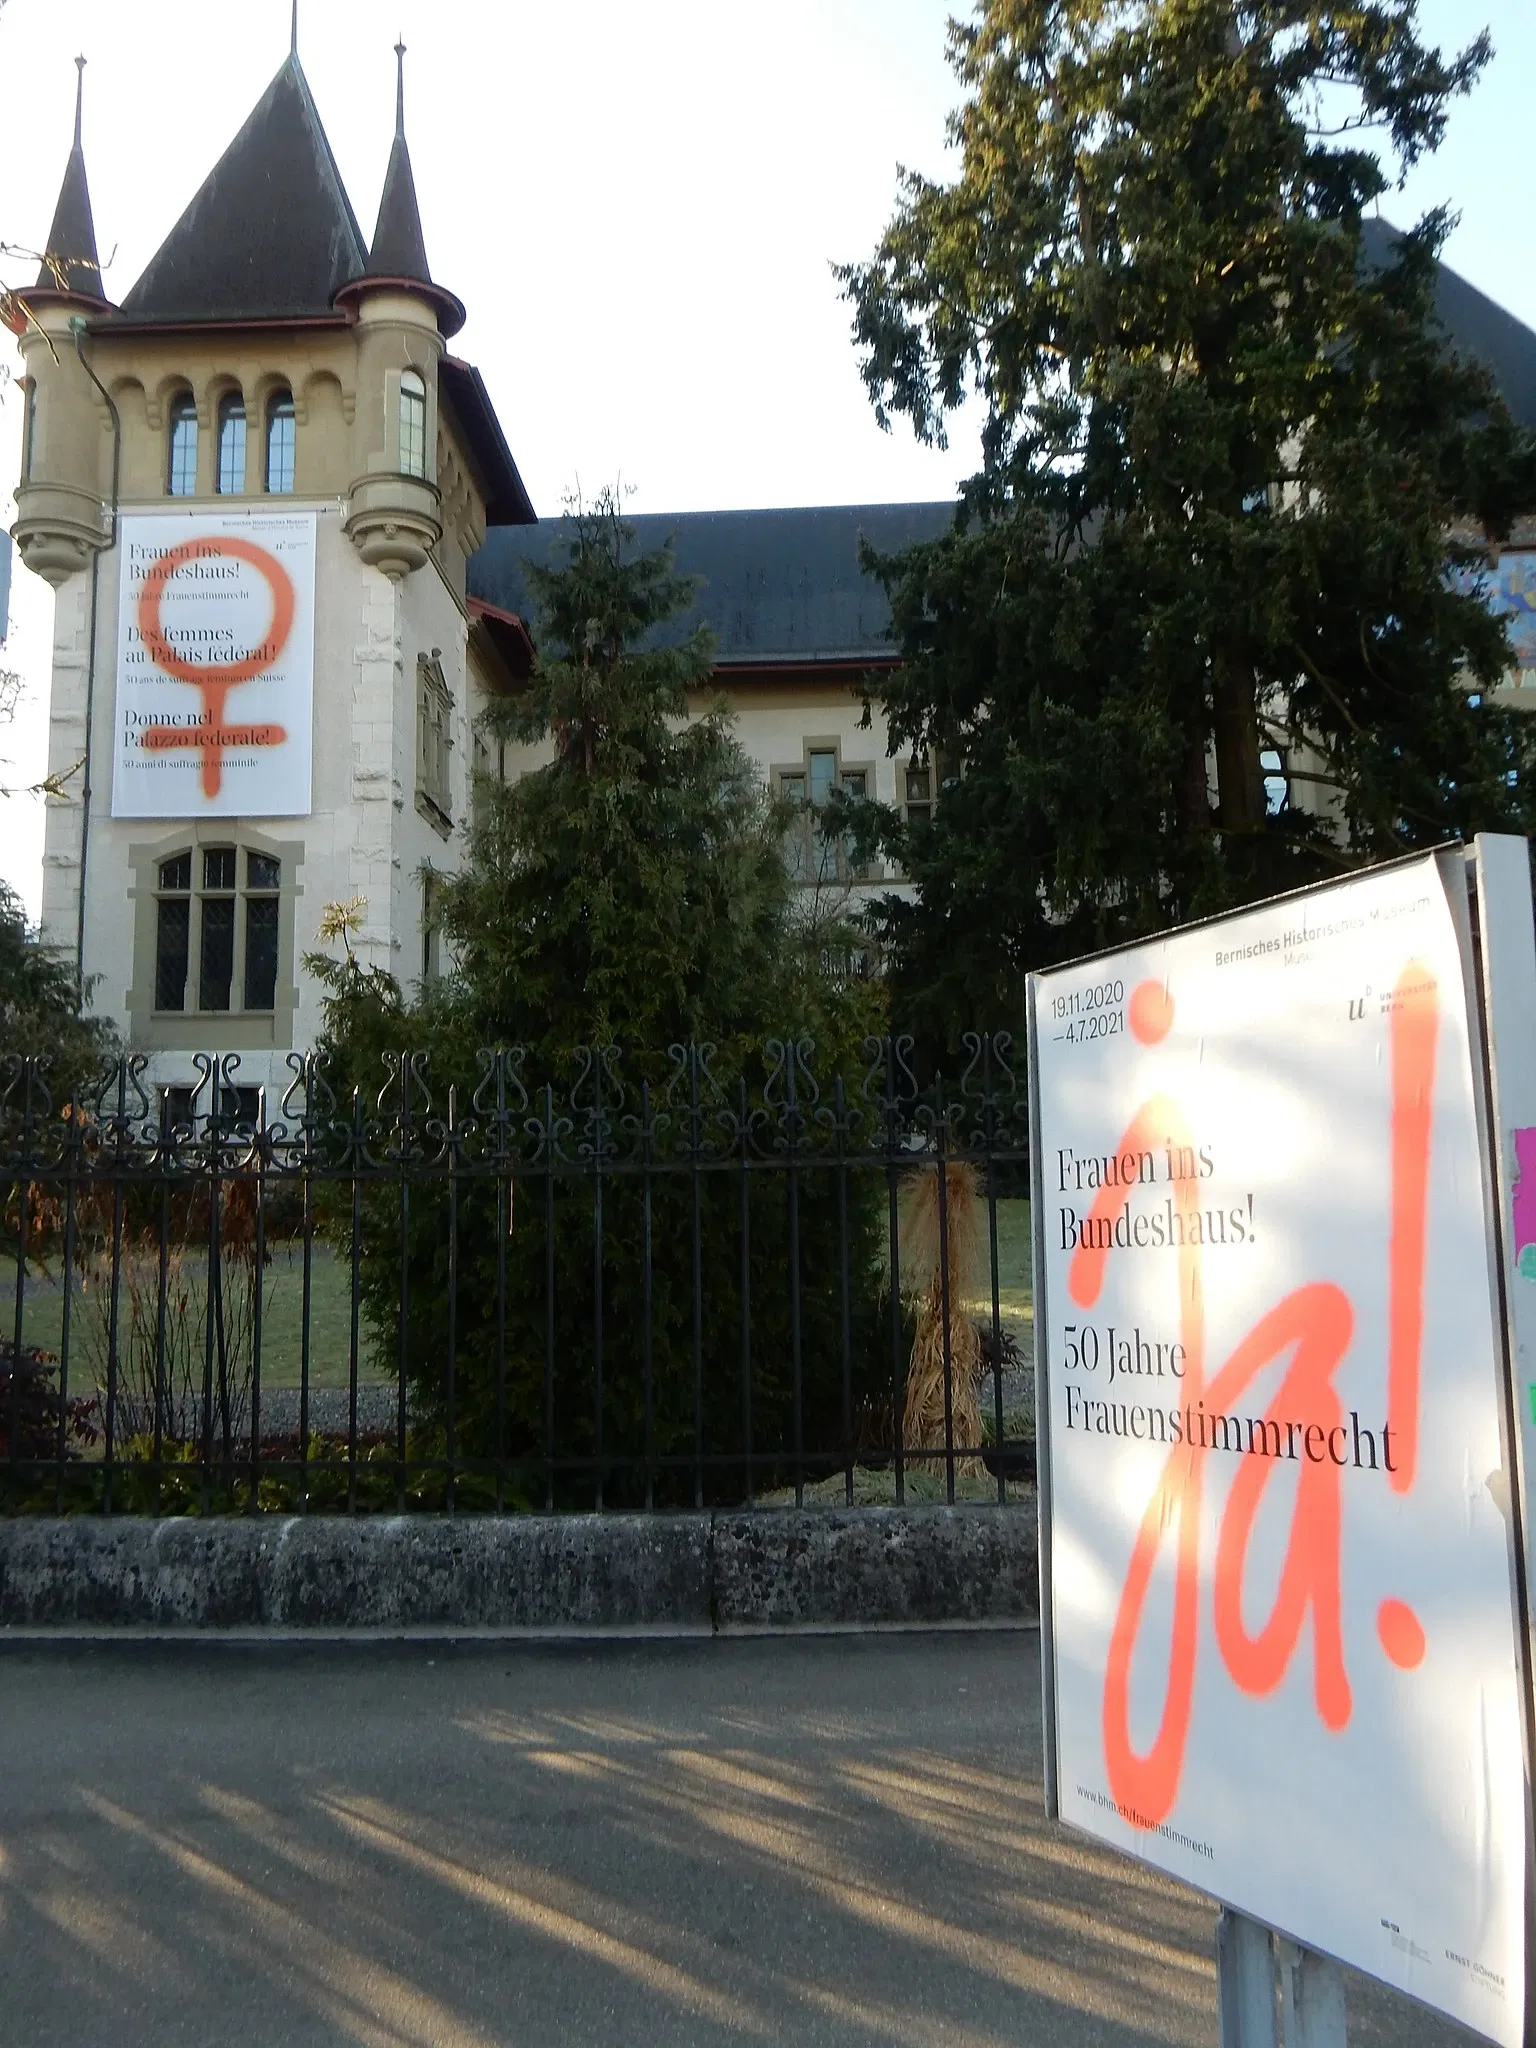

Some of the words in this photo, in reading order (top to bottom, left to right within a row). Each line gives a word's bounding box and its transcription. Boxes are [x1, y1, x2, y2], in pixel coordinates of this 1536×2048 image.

[130, 543, 190, 559] Frauen
[196, 543, 222, 558] ins
[130, 562, 240, 580] Bundeshaus!
[128, 627, 158, 642] Des
[164, 626, 234, 642] femmes
[125, 651, 145, 663] au
[151, 646, 202, 663] Palais
[155, 675, 167, 684] de
[124, 710, 182, 726] Donne
[187, 709, 213, 726] nel
[123, 731, 189, 749] Palazzo
[194, 729, 270, 747] federale!
[122, 759, 134, 768] 50
[135, 759, 156, 769] anni
[157, 759, 167, 769] di
[1215, 937, 1281, 967] Bernisches
[1052, 980, 1124, 1019] 19.11.2020
[1057, 1148, 1156, 1192] Frauen
[1165, 1136, 1214, 1182] ins
[1059, 1193, 1255, 1250] Bundeshaus!
[1064, 1324, 1099, 1372] 50
[1107, 1327, 1187, 1384] Jahre
[1064, 1384, 1399, 1472] Frauenstimmrecht
[1076, 1785, 1214, 1860] www.bhm.ch/frauenstimmrecht
